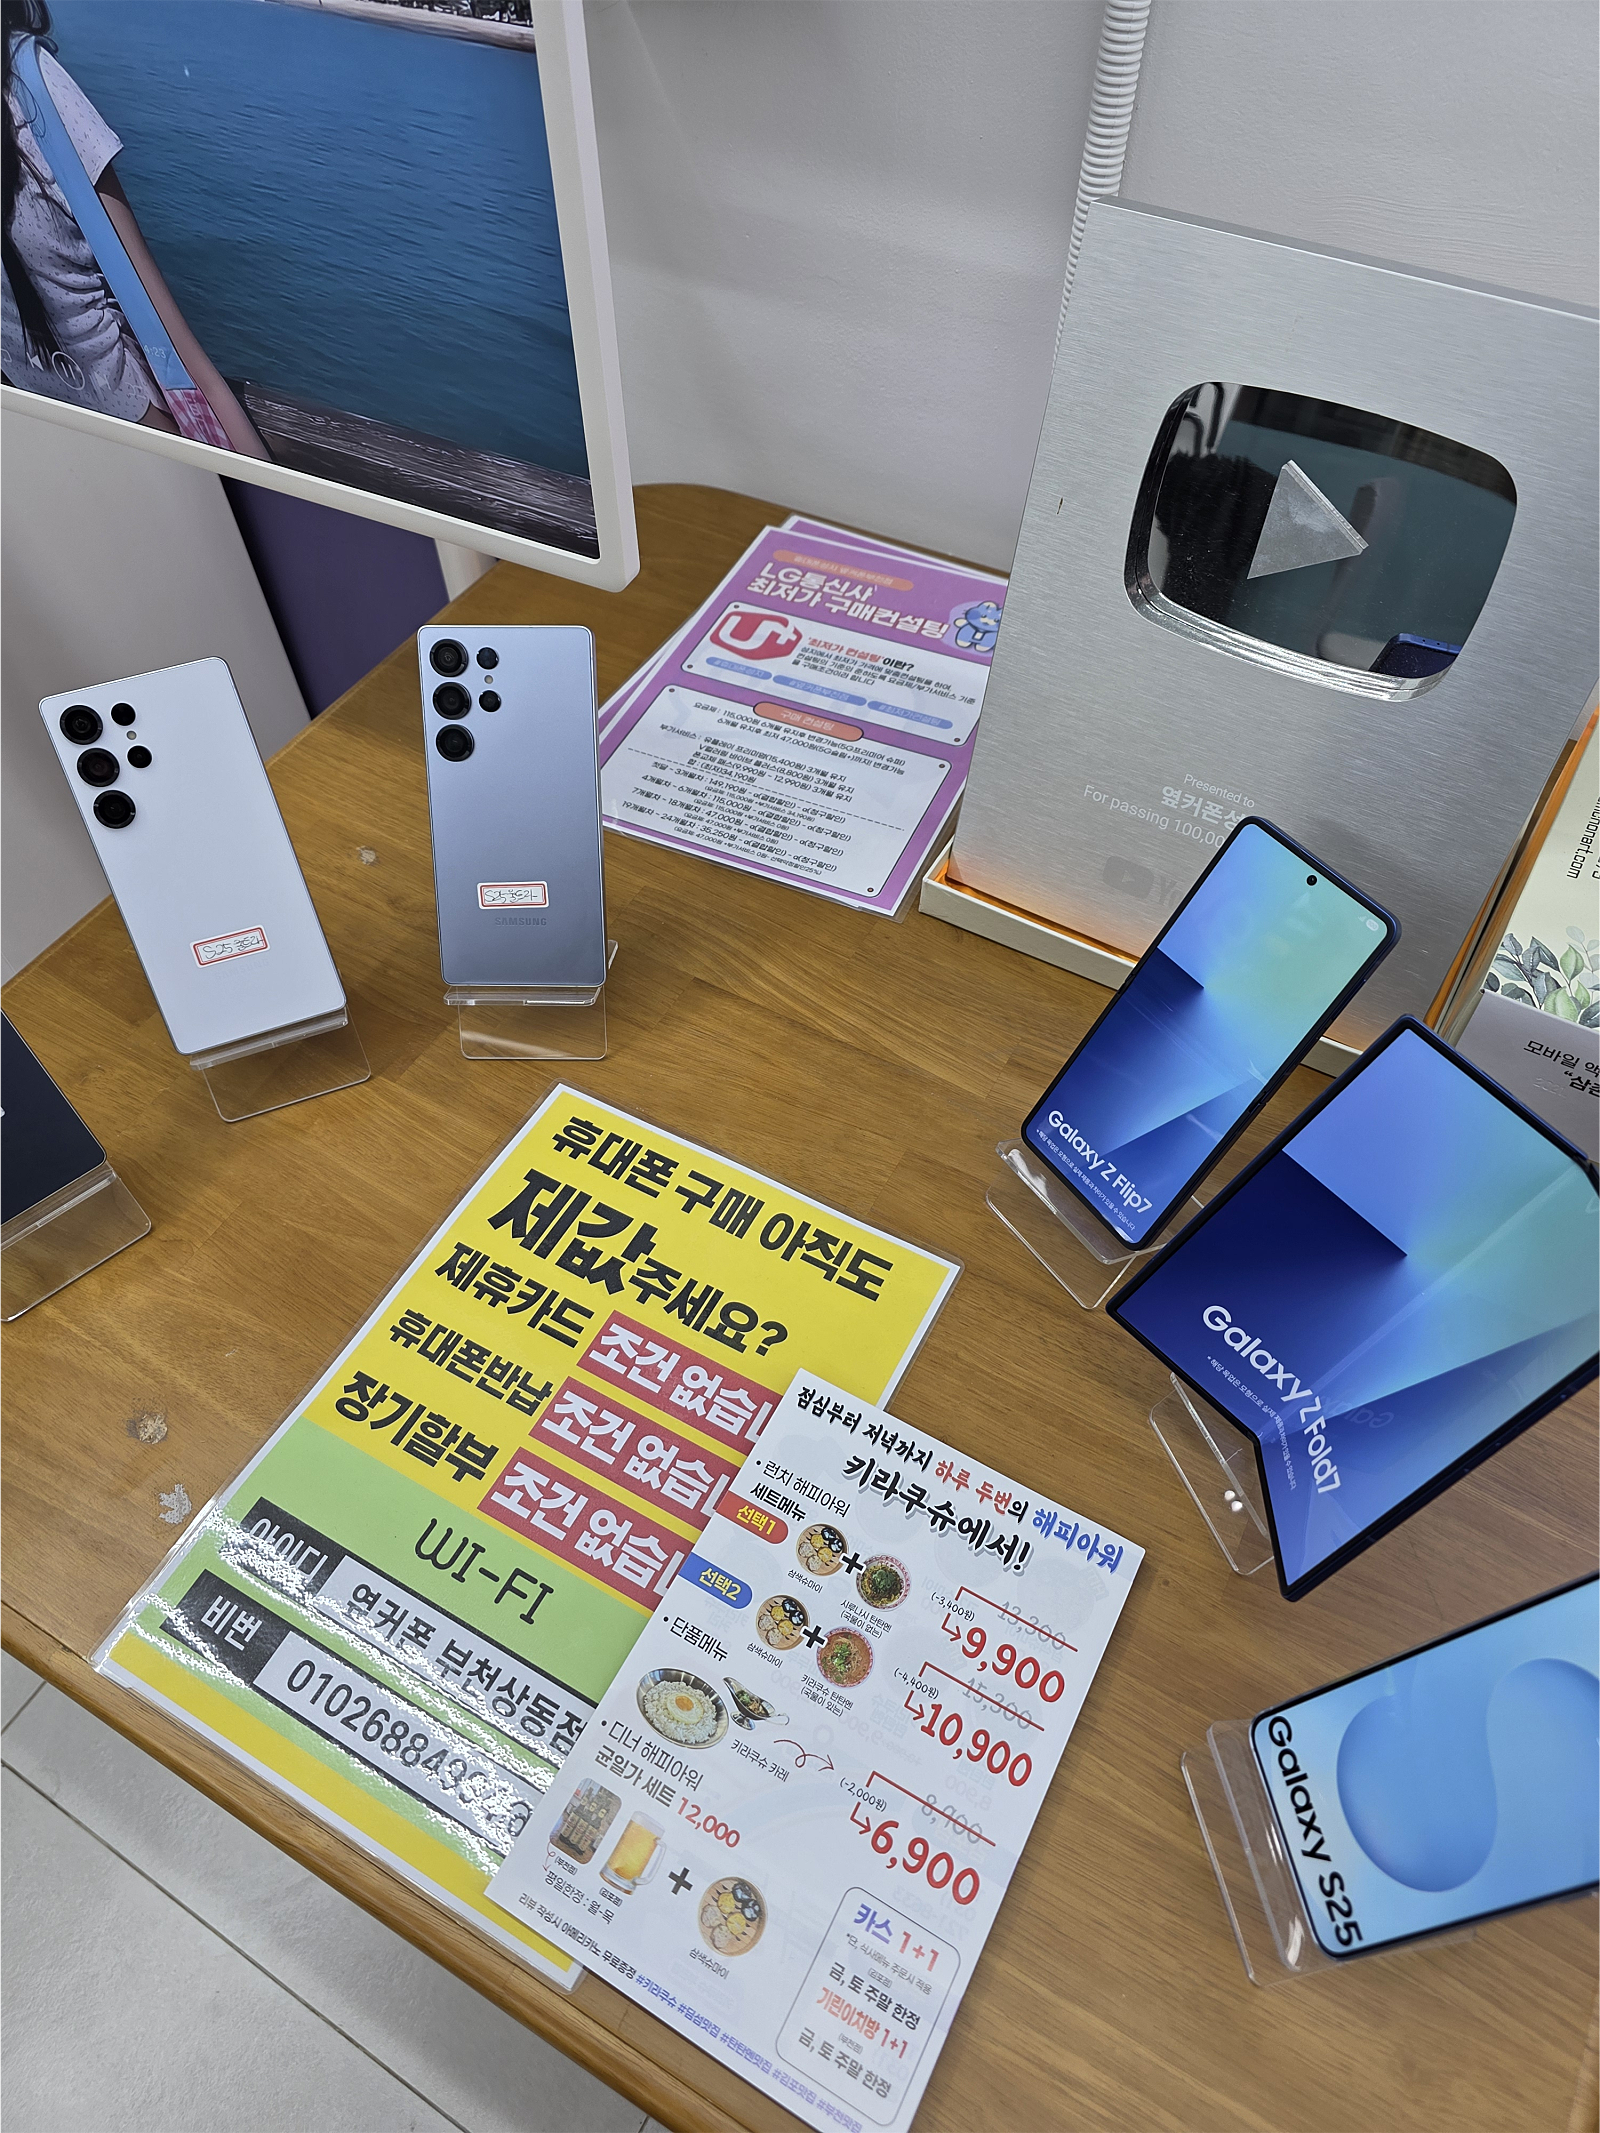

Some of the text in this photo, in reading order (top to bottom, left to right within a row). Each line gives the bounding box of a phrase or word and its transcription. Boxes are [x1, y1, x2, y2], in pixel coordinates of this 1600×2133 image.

[747, 578, 949, 639] 최저가 구매컨설팅
[760, 562, 873, 602] LG통신사
[781, 710, 835, 731] 구매 컨설팅
[1084, 784, 1109, 804] For
[1109, 798, 1170, 830] passing
[1183, 774, 1255, 808] Presented to
[494, 917, 547, 926] SAMSUNG
[202, 943, 233, 959] S25
[1523, 1040, 1580, 1069] 모바일
[1048, 1110, 1153, 1213] Galaxy Z Flip7
[552, 1116, 893, 1302] 휴대폰 구매 아직도
[434, 1242, 595, 1348] 제휴카드
[589, 1323, 681, 1393] 조건
[390, 1309, 553, 1417] 휴대폰반납
[541, 1390, 636, 1465] 조건
[1203, 1305, 1341, 1494] Galaxy Z Fold7
[335, 1370, 499, 1482] 장기할부
[491, 1461, 589, 1541] 조건
[798, 1387, 1123, 1573] 점심부터 저녁까지 하루 두번의 해피아워
[750, 1482, 806, 1522] 세트메뉴
[763, 1460, 851, 1518] 런치 해피아워
[843, 1455, 1030, 1570] 키라쿠슈에서!
[736, 1505, 776, 1535] 선택1
[415, 1518, 554, 1625] WI-FI
[699, 1568, 741, 1601] 선택2
[787, 1569, 823, 1593] 삼색슈마이
[201, 1595, 262, 1651] 비번
[345, 1582, 441, 1658] 옆커폰
[840, 1600, 892, 1633] 시루나시 탄탄멘
[840, 1610, 883, 1639] (국물이 없는)
[931, 1592, 975, 1622] (-3,400원)
[996, 1600, 1065, 1653] 13,300
[670, 1617, 728, 1662] 단품메뉴
[747, 1643, 783, 1668] 삼색슈마이
[962, 1627, 1065, 1703] 9,900
[801, 1674, 854, 1711] 키라쿠슈 탄탄멘
[801, 1686, 844, 1717] (국물이 있는)
[894, 1667, 939, 1700] (-4,400원)
[961, 1677, 1032, 1732] 15,300
[608, 1721, 704, 1792] 디너 해피아워
[731, 1739, 790, 1782] 키라쿠슈 카레
[921, 1704, 1032, 1787] 10,900
[595, 1745, 740, 1848] 균일가 세트 12,000
[840, 1777, 887, 1812] (-2,000원)
[919, 1793, 982, 1846] 8,900
[1268, 1715, 1363, 1947] Galaxy S25
[554, 1856, 578, 1876] (부천점)
[871, 1820, 980, 1905] 6,900
[545, 1870, 614, 1925] 평일한정 월-목
[599, 1887, 623, 1907] (김포점)
[689, 1948, 729, 1979] 삼색슈마이
[853, 1903, 939, 1972] 카스 1+1
[860, 1943, 890, 1968] 식사메뉴
[891, 1963, 916, 1985] 주문시
[915, 1978, 932, 1995] 적용
[867, 1967, 892, 1989] (김포점)
[518, 1893, 537, 1910] 리뷰
[536, 1904, 563, 1928] 작성시
[561, 1922, 601, 1957] 아메리카노
[602, 1950, 637, 1979] 무료증정
[636, 1974, 677, 2008] #키라쿠슈
[677, 2003, 721, 2038] #딤섬맛집
[720, 2032, 772, 2074] #탄탄멘맛집
[772, 2068, 817, 2105] #김포맛집
[829, 1962, 921, 2030] 금, 토 주말 한정
[816, 1987, 908, 2059] 기린이치방 1+1
[838, 2033, 863, 2055] (부천점)
[798, 2027, 892, 2098] 금, 토 주말 한정
